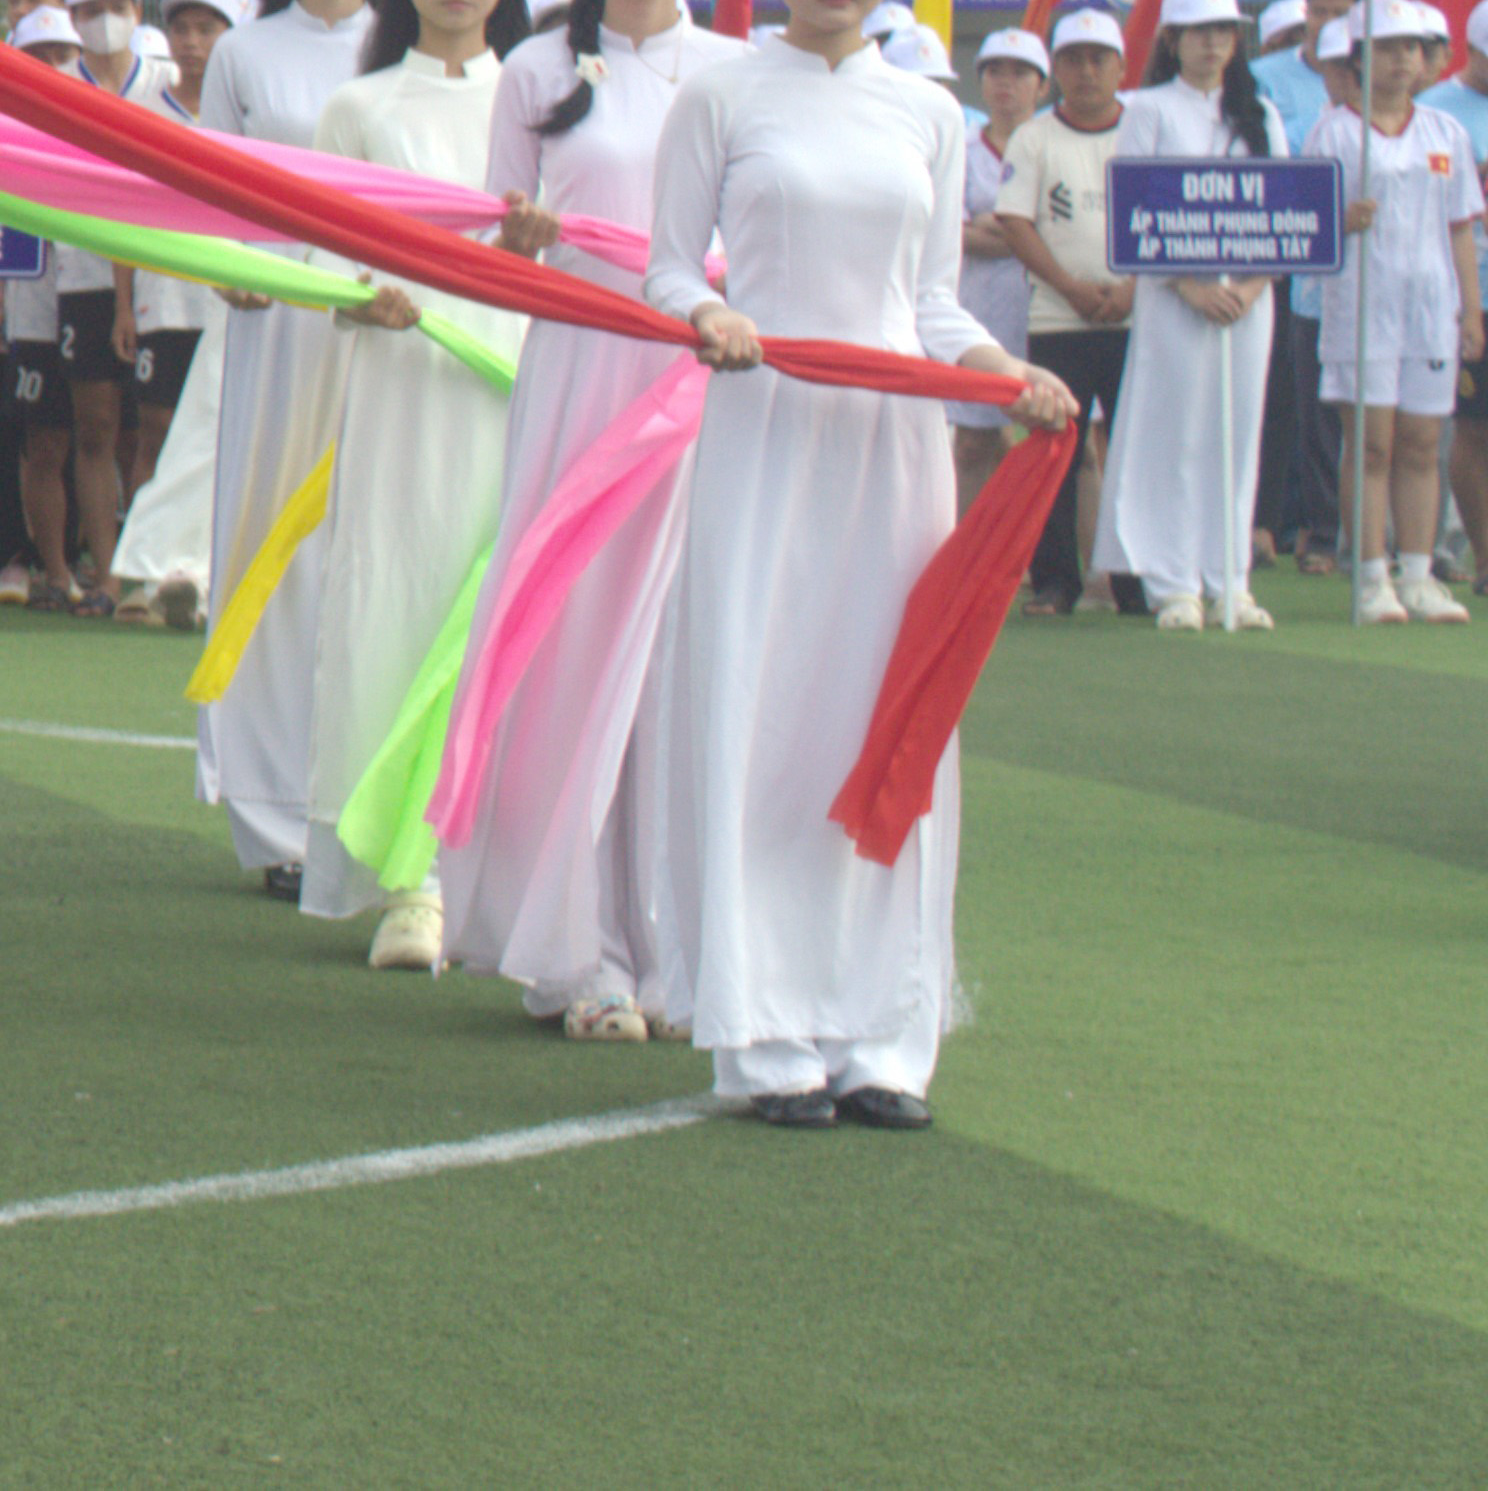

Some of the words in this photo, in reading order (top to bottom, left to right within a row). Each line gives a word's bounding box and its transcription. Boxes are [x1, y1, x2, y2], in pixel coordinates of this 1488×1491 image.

[1182, 169, 1235, 202] ĐƠN
[1239, 172, 1265, 208] VỊ
[1129, 206, 1153, 234] ẤP
[1156, 207, 1211, 234] THÀNH
[1213, 210, 1270, 237] PHỤNG
[1272, 207, 1319, 234] ĐÔNG
[1138, 231, 1162, 259] ẤP
[1163, 232, 1219, 259] THÀNH
[1221, 235, 1278, 262] PHỤNG
[1280, 233, 1312, 259] TÂY
[61, 324, 75, 360] 2
[136, 347, 154, 383] 6
[15, 365, 43, 402] 10
